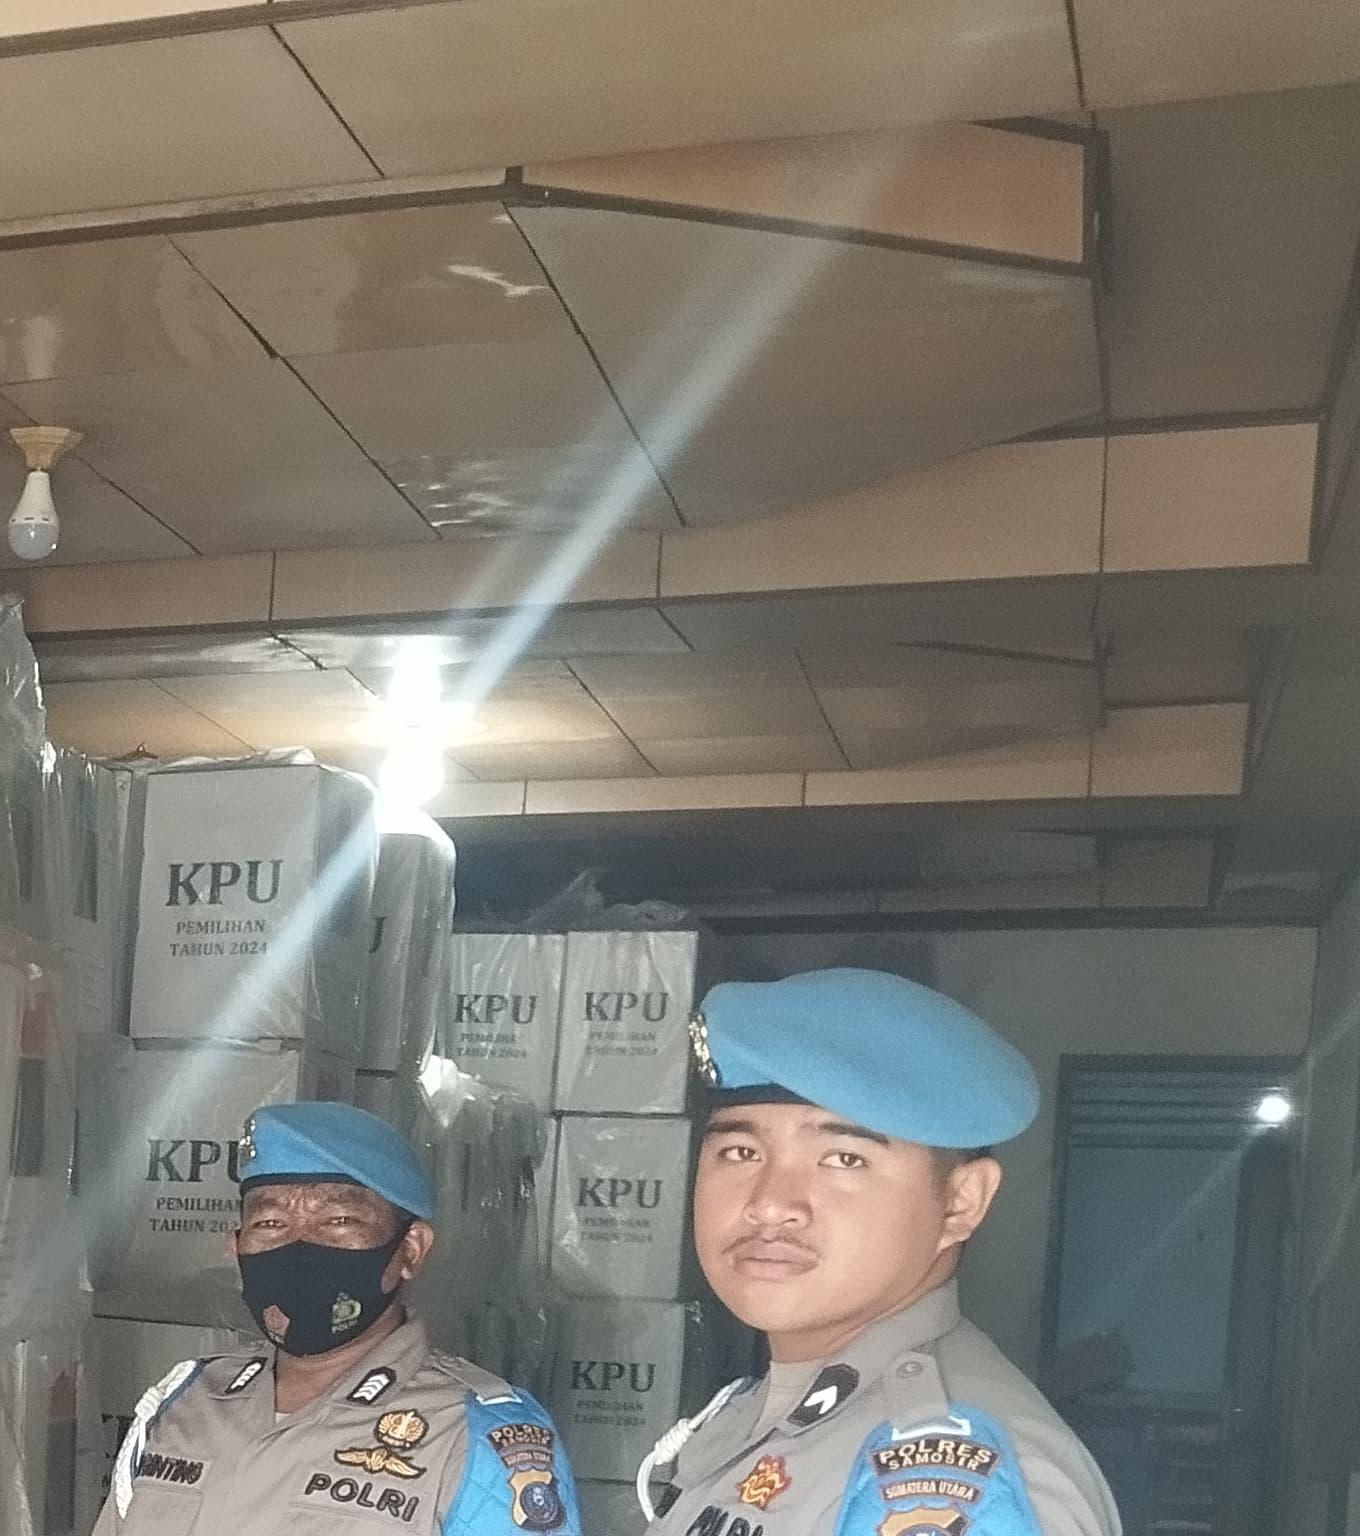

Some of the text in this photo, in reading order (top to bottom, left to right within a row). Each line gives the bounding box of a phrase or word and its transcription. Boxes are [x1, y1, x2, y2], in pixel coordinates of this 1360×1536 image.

[165, 859, 284, 906] KPU
[176, 919, 266, 935] PEMILIHAN
[170, 942, 224, 957] TAHUN
[454, 993, 538, 1024] KPU
[583, 991, 669, 1023] KPU
[576, 1177, 662, 1209] KPU
[568, 1360, 656, 1393] KPU
[880, 1439, 993, 1465] POLRES
[888, 1453, 979, 1471] SAMOSIR
[304, 1472, 420, 1523] POLRI
[939, 1480, 975, 1501] UTARA
